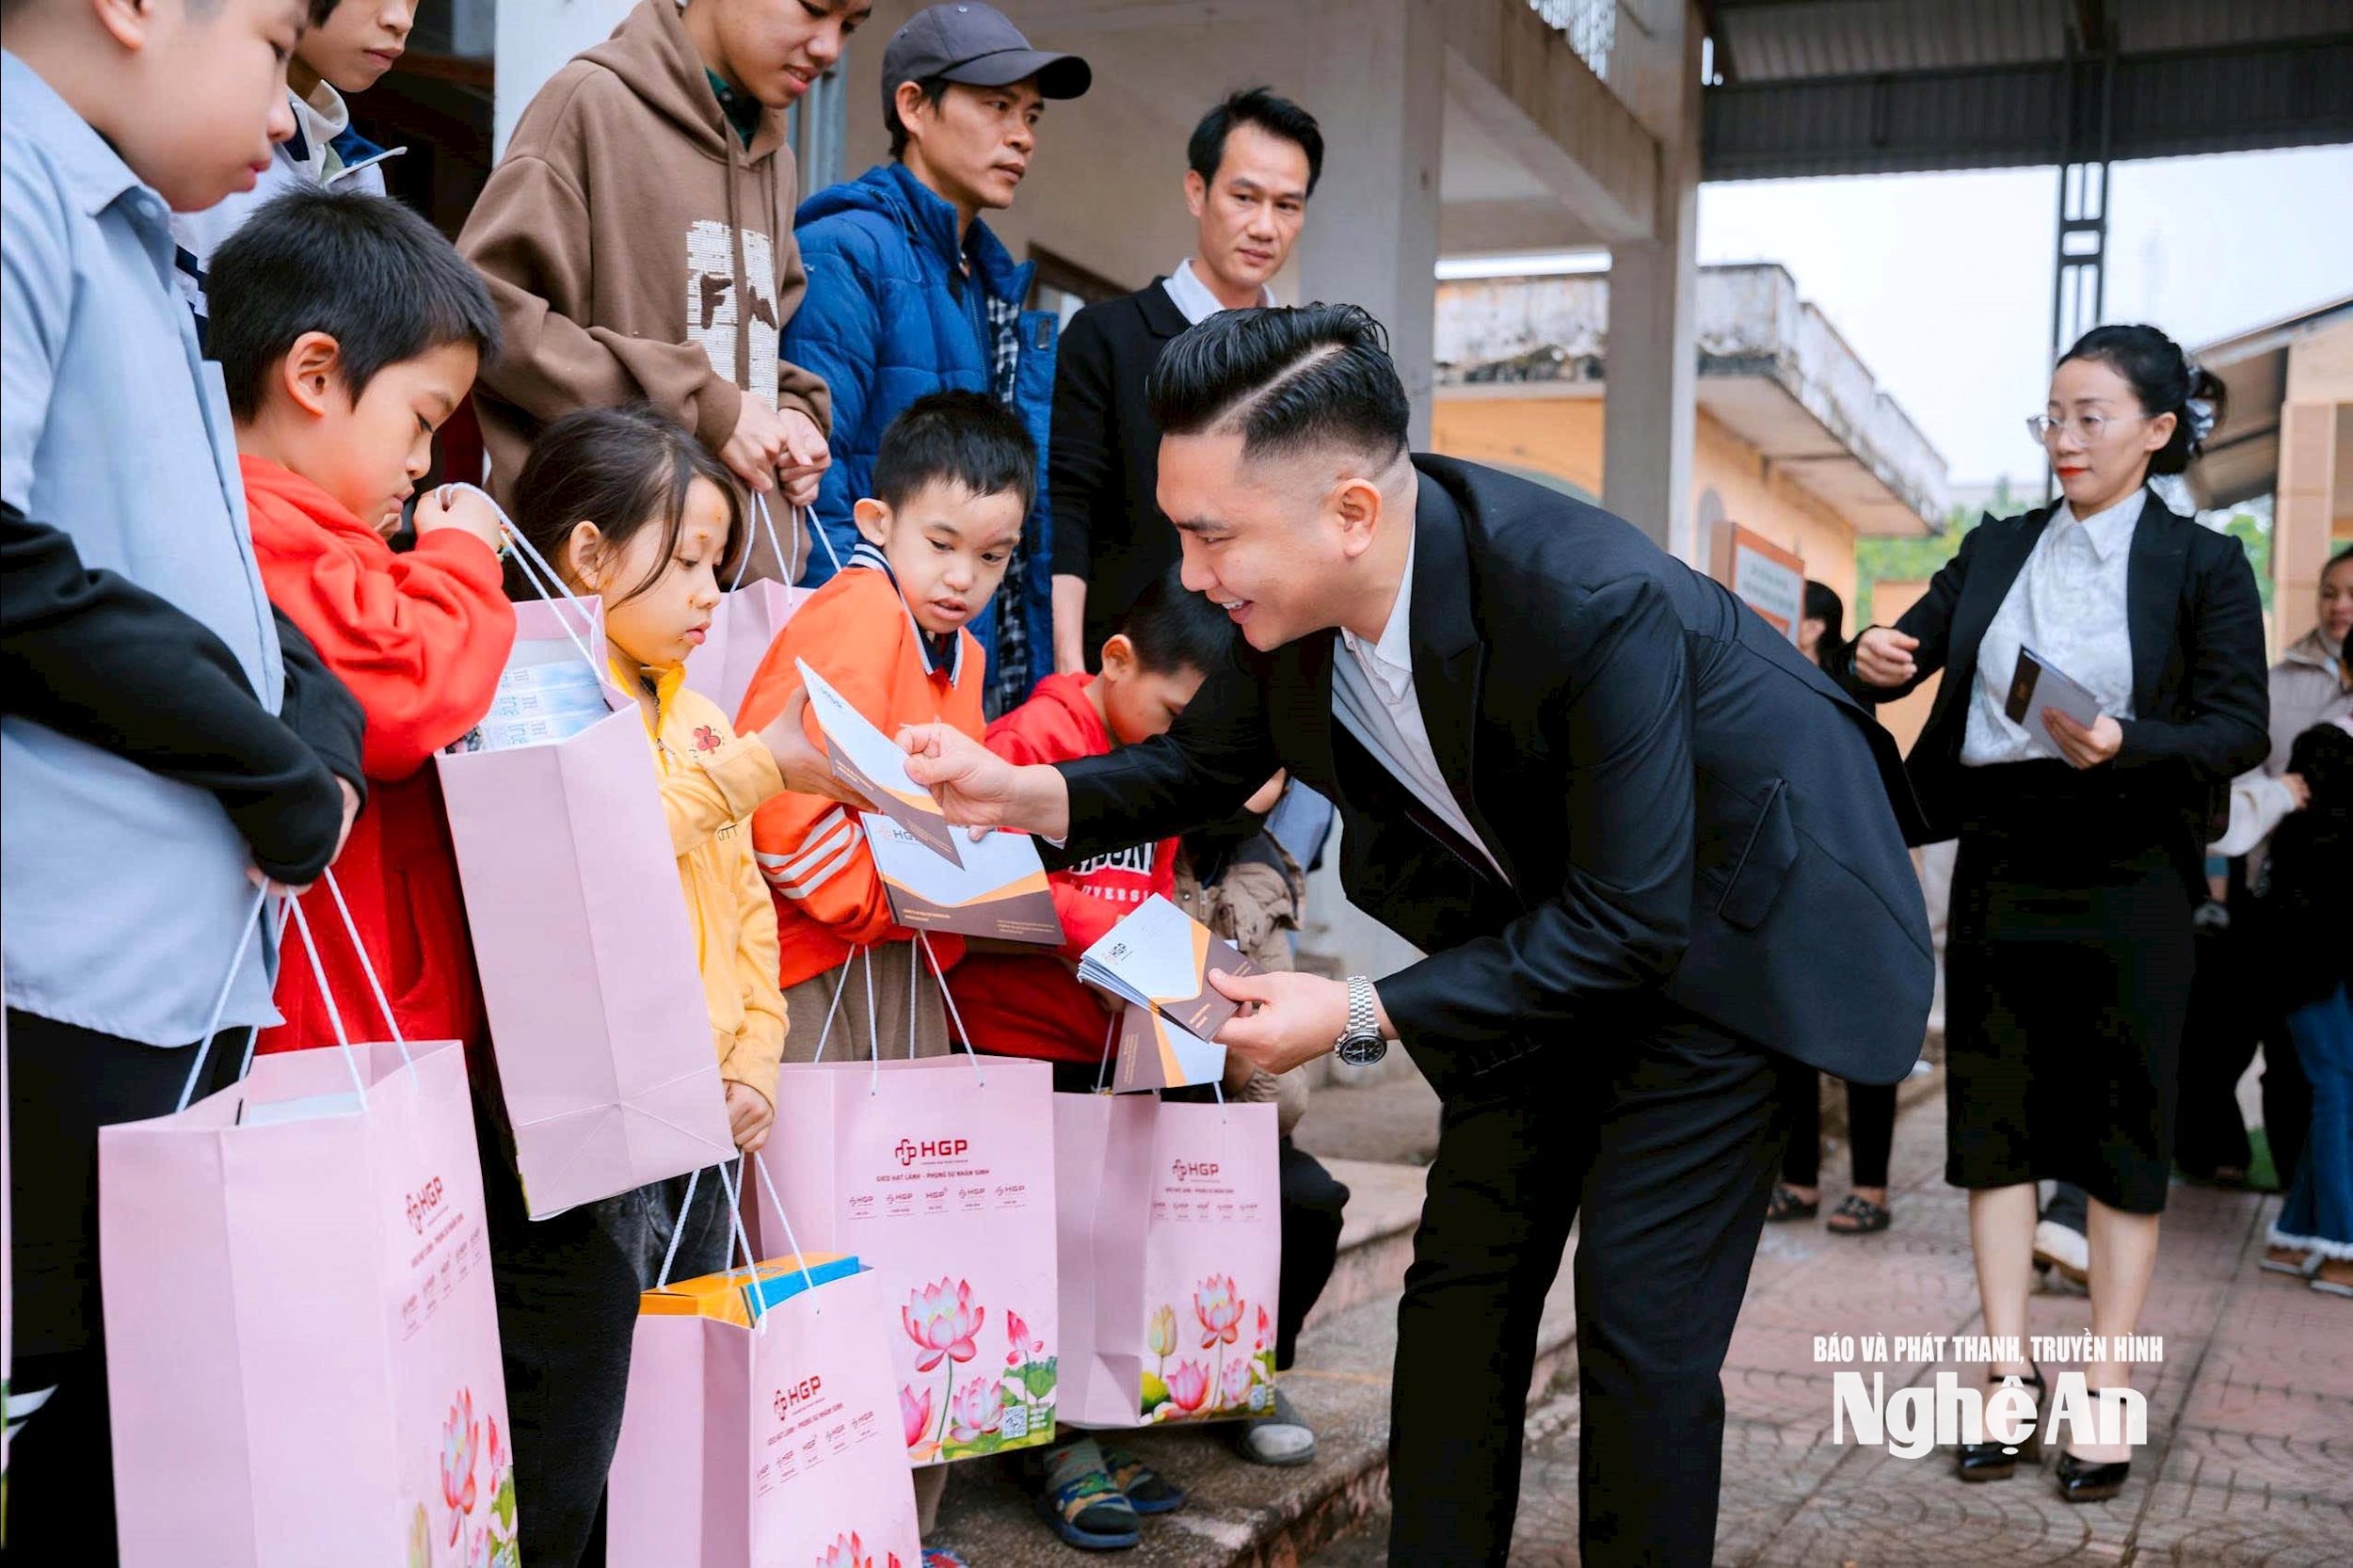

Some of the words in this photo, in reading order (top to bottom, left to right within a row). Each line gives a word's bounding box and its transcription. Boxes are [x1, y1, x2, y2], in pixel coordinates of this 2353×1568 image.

[893, 829, 918, 841] HG
[1110, 942, 1128, 958] HGP
[920, 1139, 968, 1157] HGP
[1188, 1163, 1219, 1176] HGP
[417, 1176, 443, 1215] HGP
[788, 1375, 822, 1407] HGP
